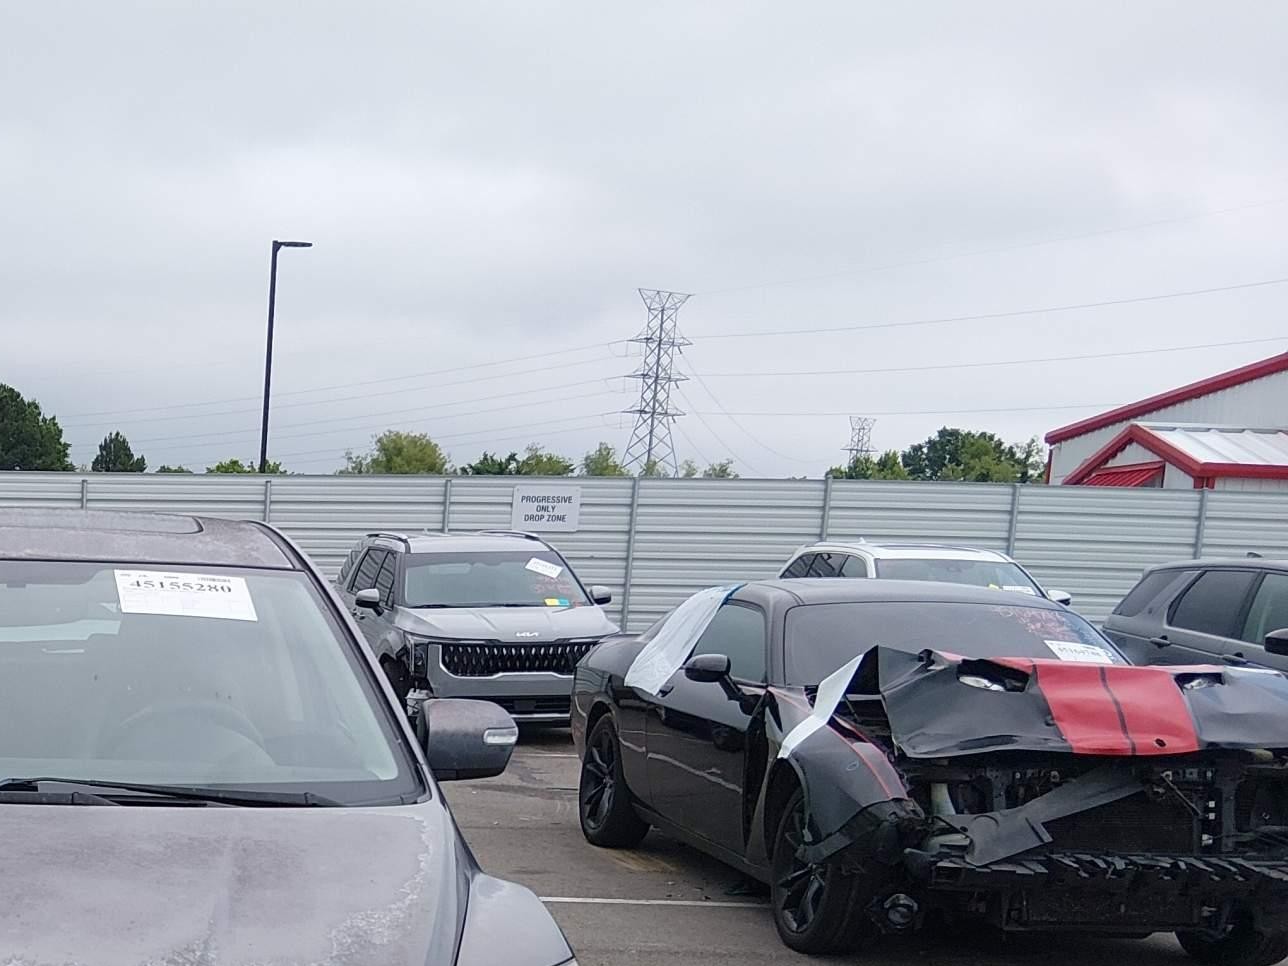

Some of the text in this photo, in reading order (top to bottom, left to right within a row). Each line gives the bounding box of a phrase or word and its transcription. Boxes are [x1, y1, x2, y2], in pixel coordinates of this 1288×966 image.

[520, 495, 573, 504] PROGRESSIVE
[535, 504, 557, 513] ONLY
[523, 514, 567, 522] DROP ZONE
[130, 580, 232, 593] 45155280
